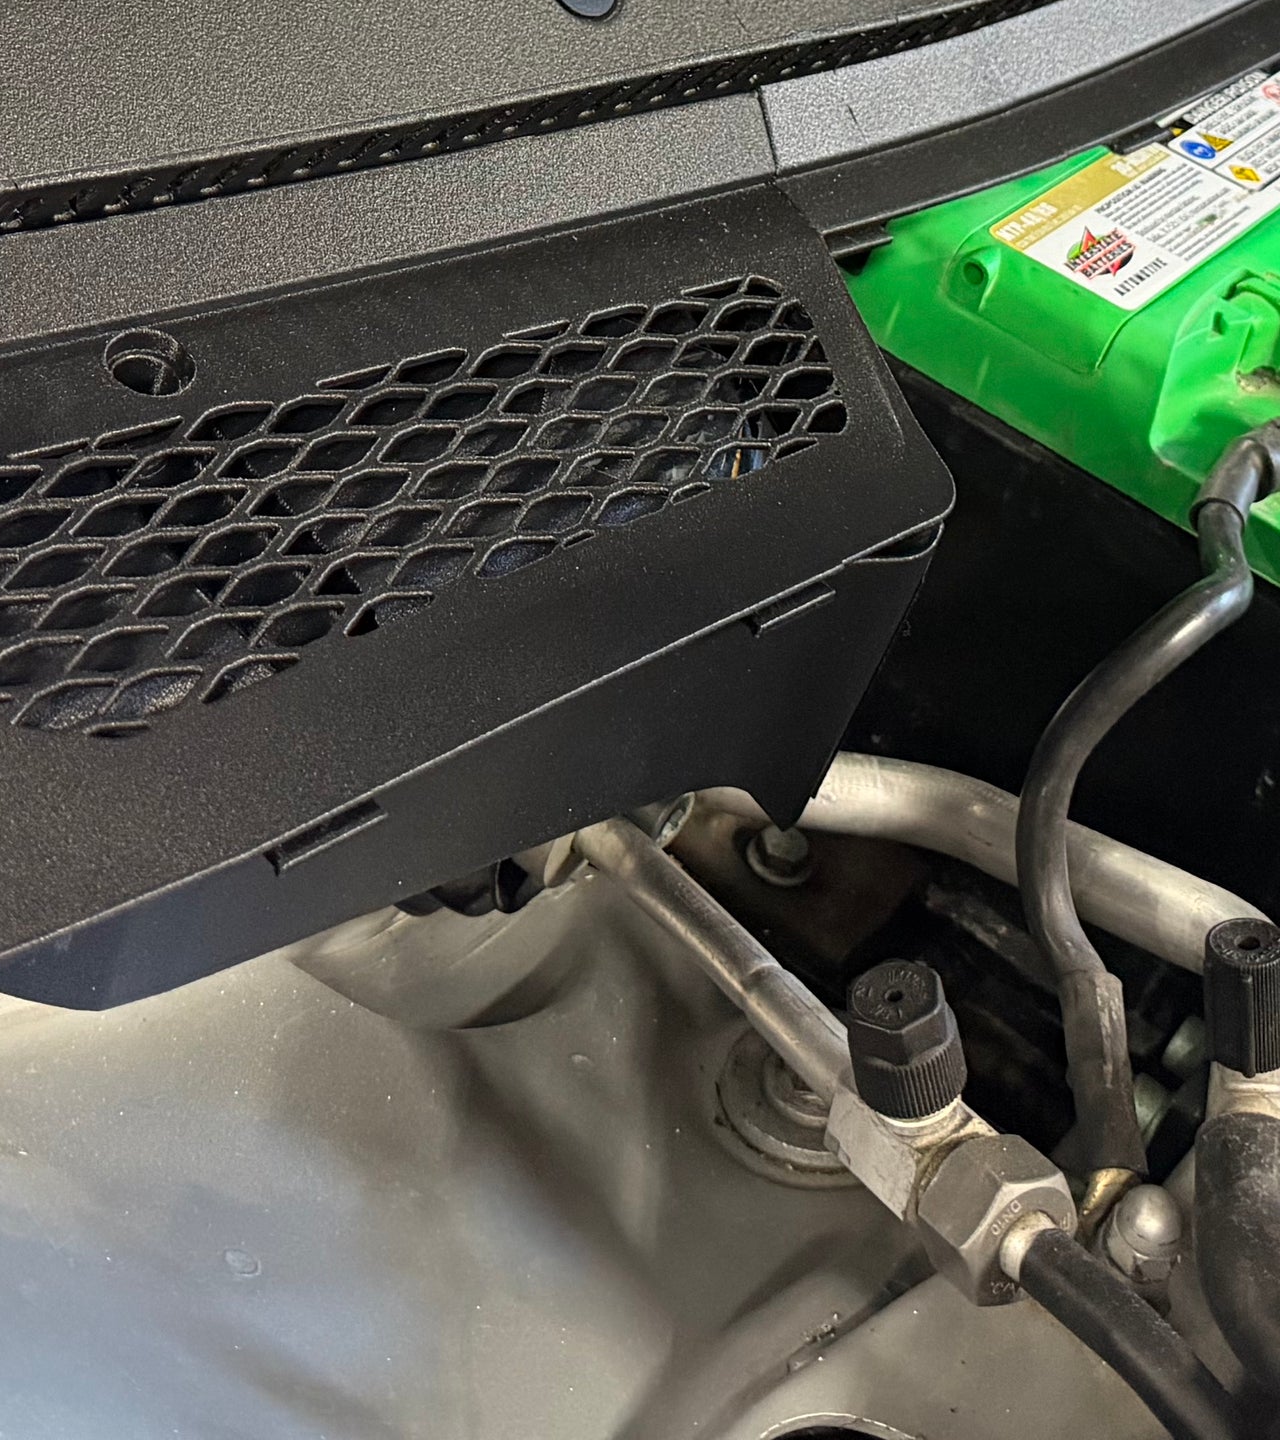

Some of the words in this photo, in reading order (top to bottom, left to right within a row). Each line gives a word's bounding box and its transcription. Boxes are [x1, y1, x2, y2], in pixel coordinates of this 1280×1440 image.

[1064, 227, 1124, 271] INTERSTATE
[1080, 240, 1133, 278] BATTERIES
[1114, 257, 1169, 296] AUTOMOTIVE
